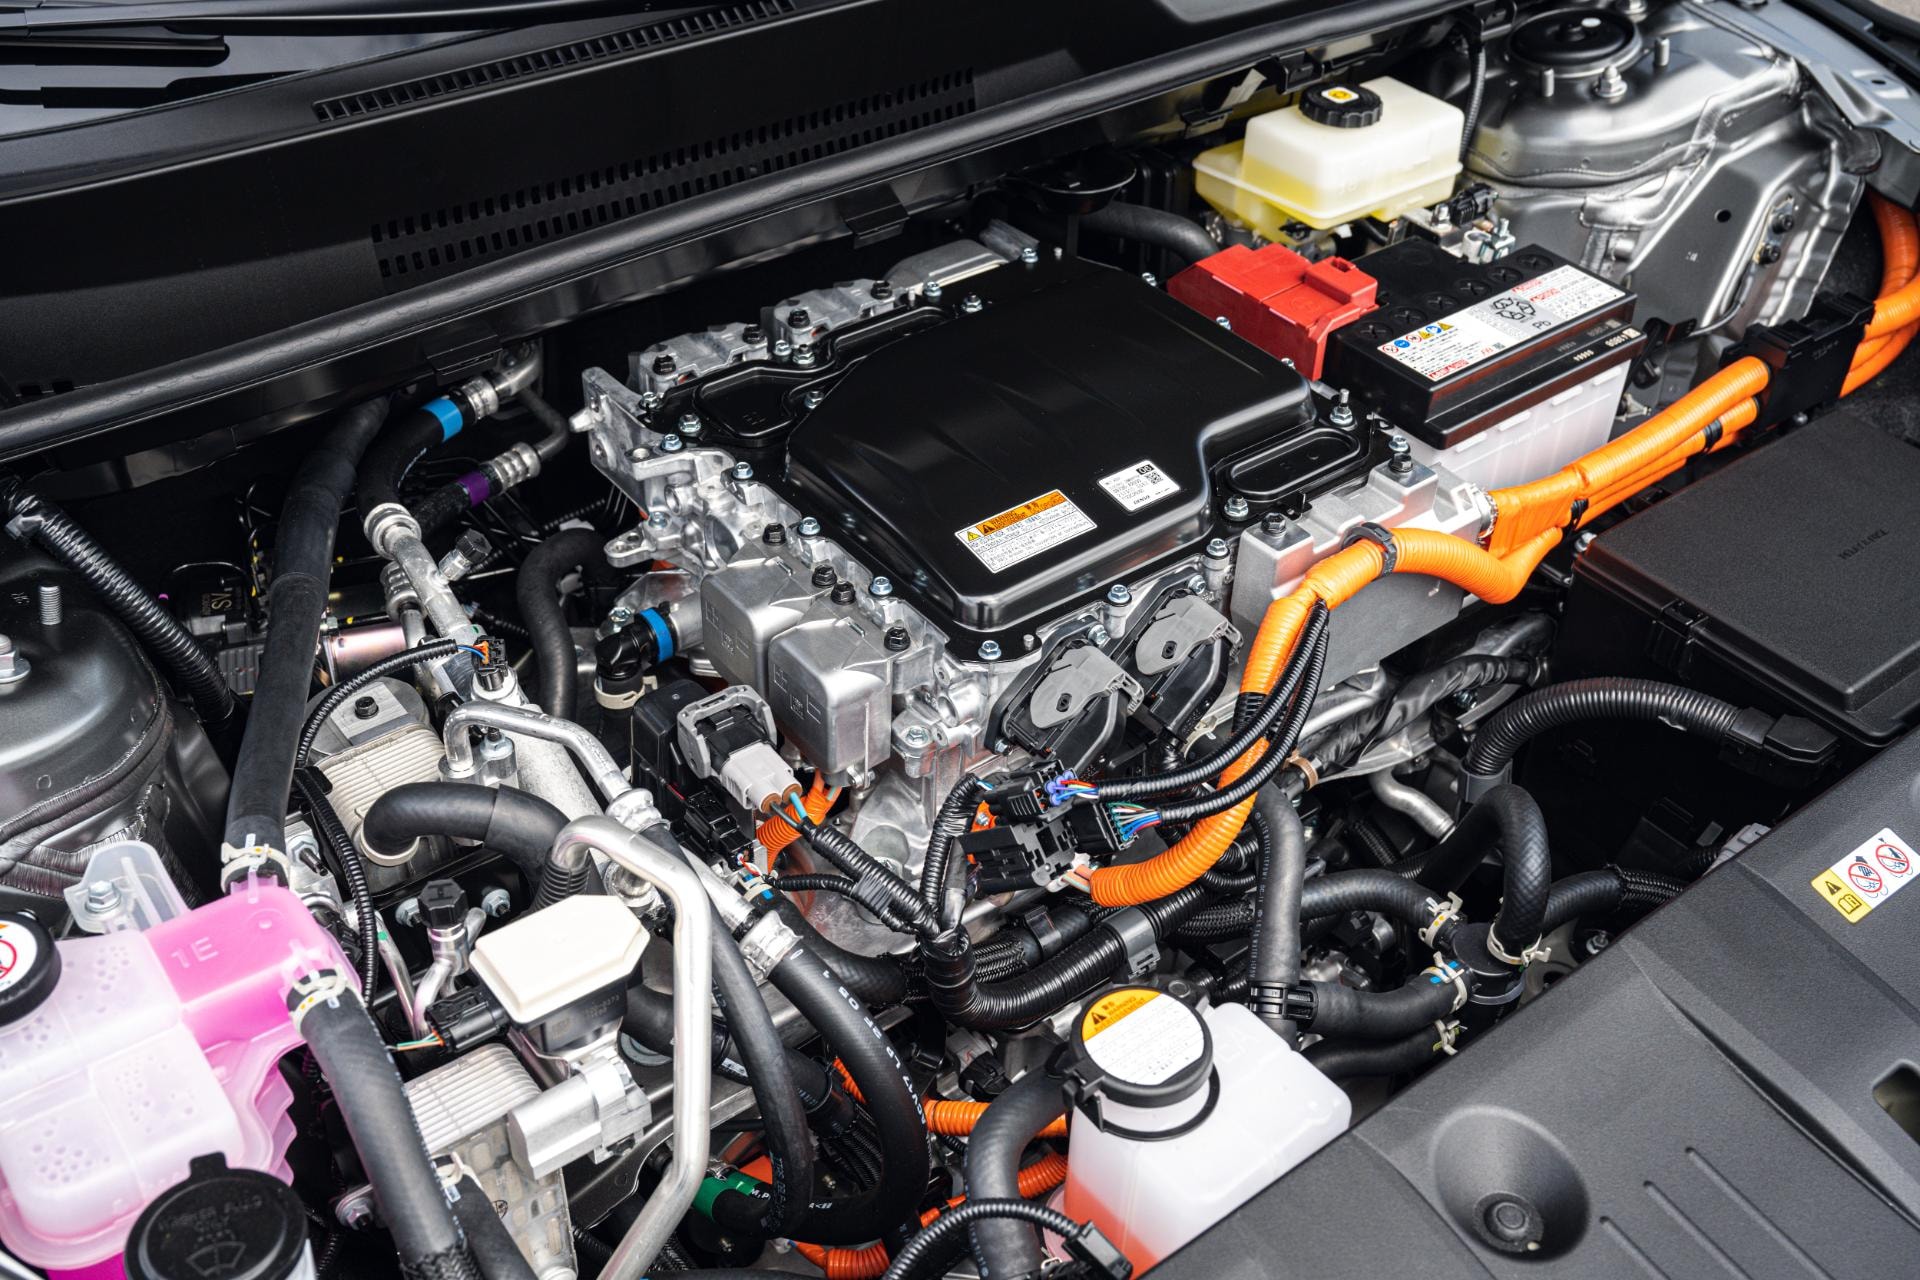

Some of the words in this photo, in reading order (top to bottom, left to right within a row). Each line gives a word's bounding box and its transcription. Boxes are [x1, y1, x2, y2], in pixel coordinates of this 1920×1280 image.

[171, 936, 218, 968] 1E
[838, 985, 860, 1010] 05
[885, 1046, 902, 1069] LP
